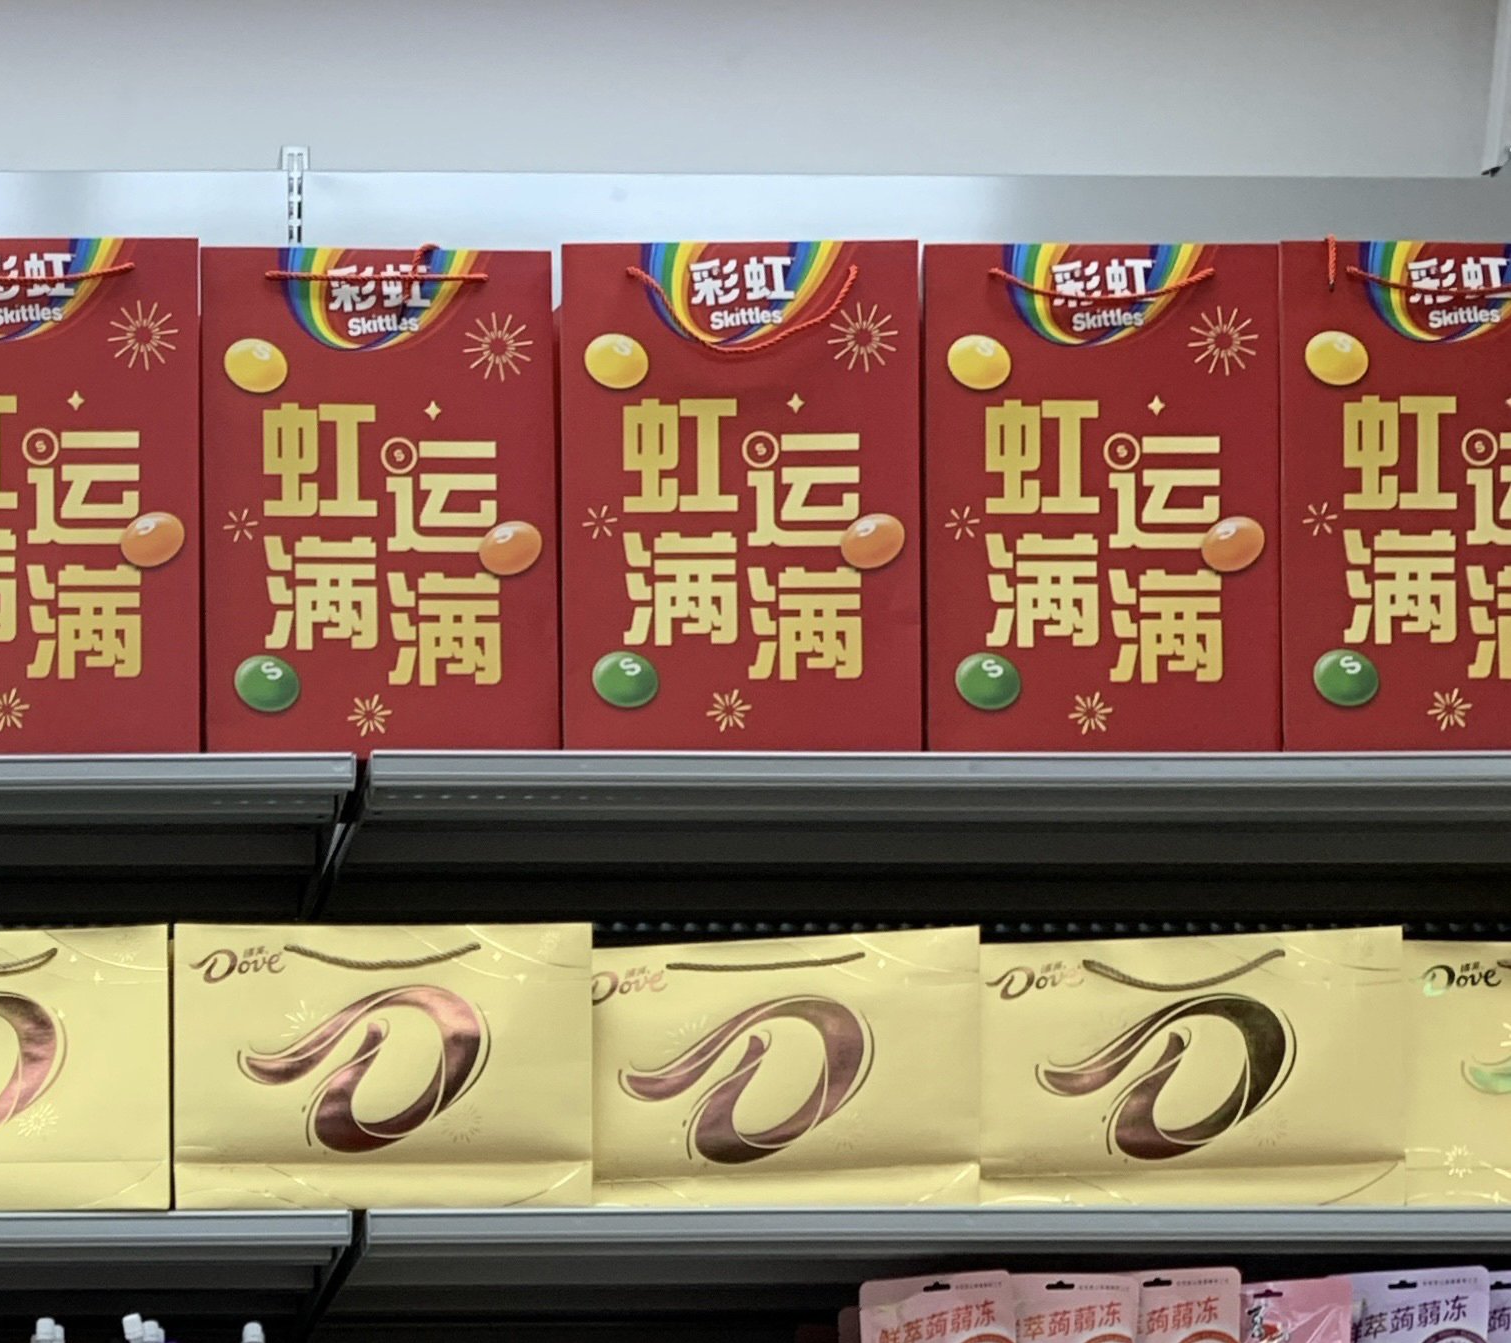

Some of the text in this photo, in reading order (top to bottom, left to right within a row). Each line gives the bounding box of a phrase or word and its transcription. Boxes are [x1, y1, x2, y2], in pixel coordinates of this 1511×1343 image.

[327, 263, 431, 313] 彩虹
[690, 257, 795, 306] 彩虹
[1051, 259, 1153, 309] 彩虹
[1409, 257, 1508, 305] 彩虹
[347, 313, 419, 337] Skittles
[709, 306, 783, 331] Skittles
[1072, 308, 1144, 333] Skittles
[1428, 304, 1501, 329] Skittles
[189, 948, 286, 984] Dove
[985, 965, 1084, 1000] Dove
[1411, 963, 1502, 997] Dove
[592, 968, 668, 1005] Dove
[1016, 1301, 1123, 1341] 萃蒟蒻冻
